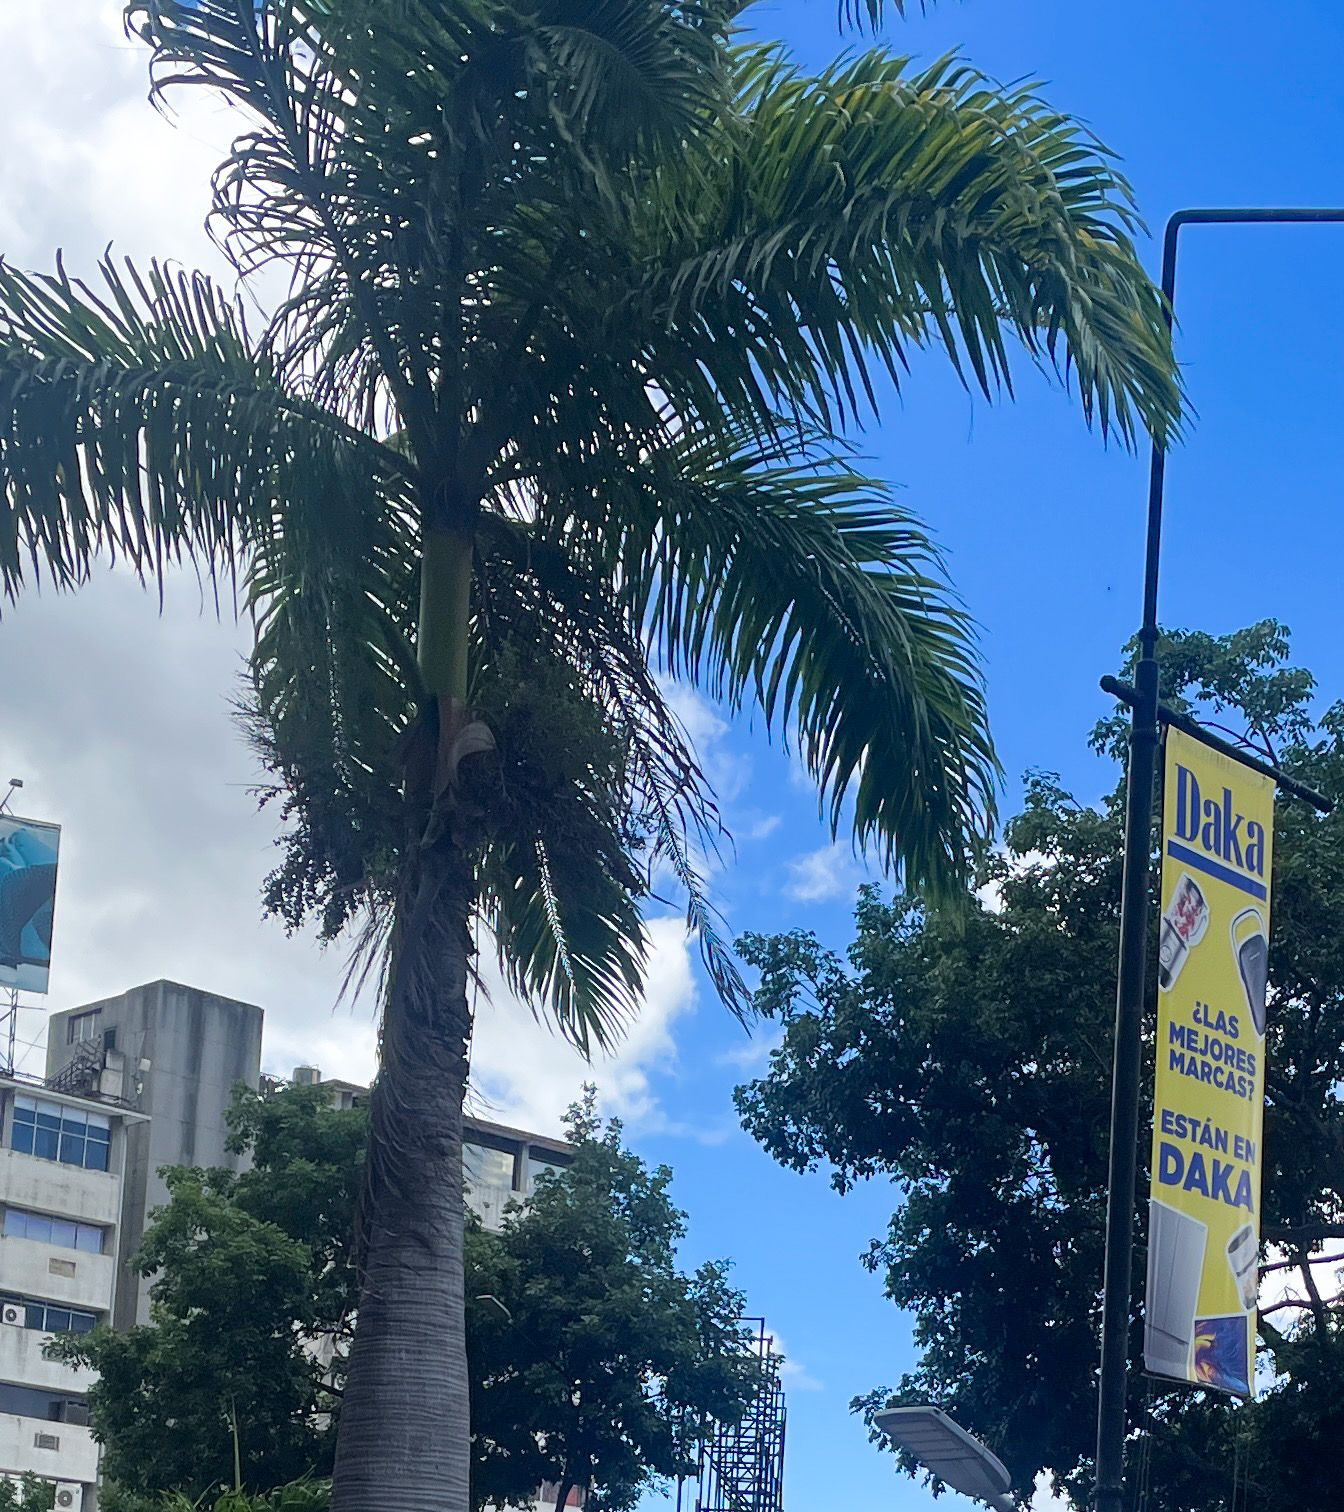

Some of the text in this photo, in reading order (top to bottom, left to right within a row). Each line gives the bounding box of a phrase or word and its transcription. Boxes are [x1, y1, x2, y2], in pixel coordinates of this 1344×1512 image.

[1175, 763, 1264, 878] Daka
[1169, 1020, 1256, 1077] MEJORES
[1192, 1001, 1239, 1039] ¿LAS
[1169, 1048, 1255, 1101] MARCAS?
[1161, 1108, 1256, 1166] ESTÁN EN
[1158, 1141, 1254, 1214] DAKA
